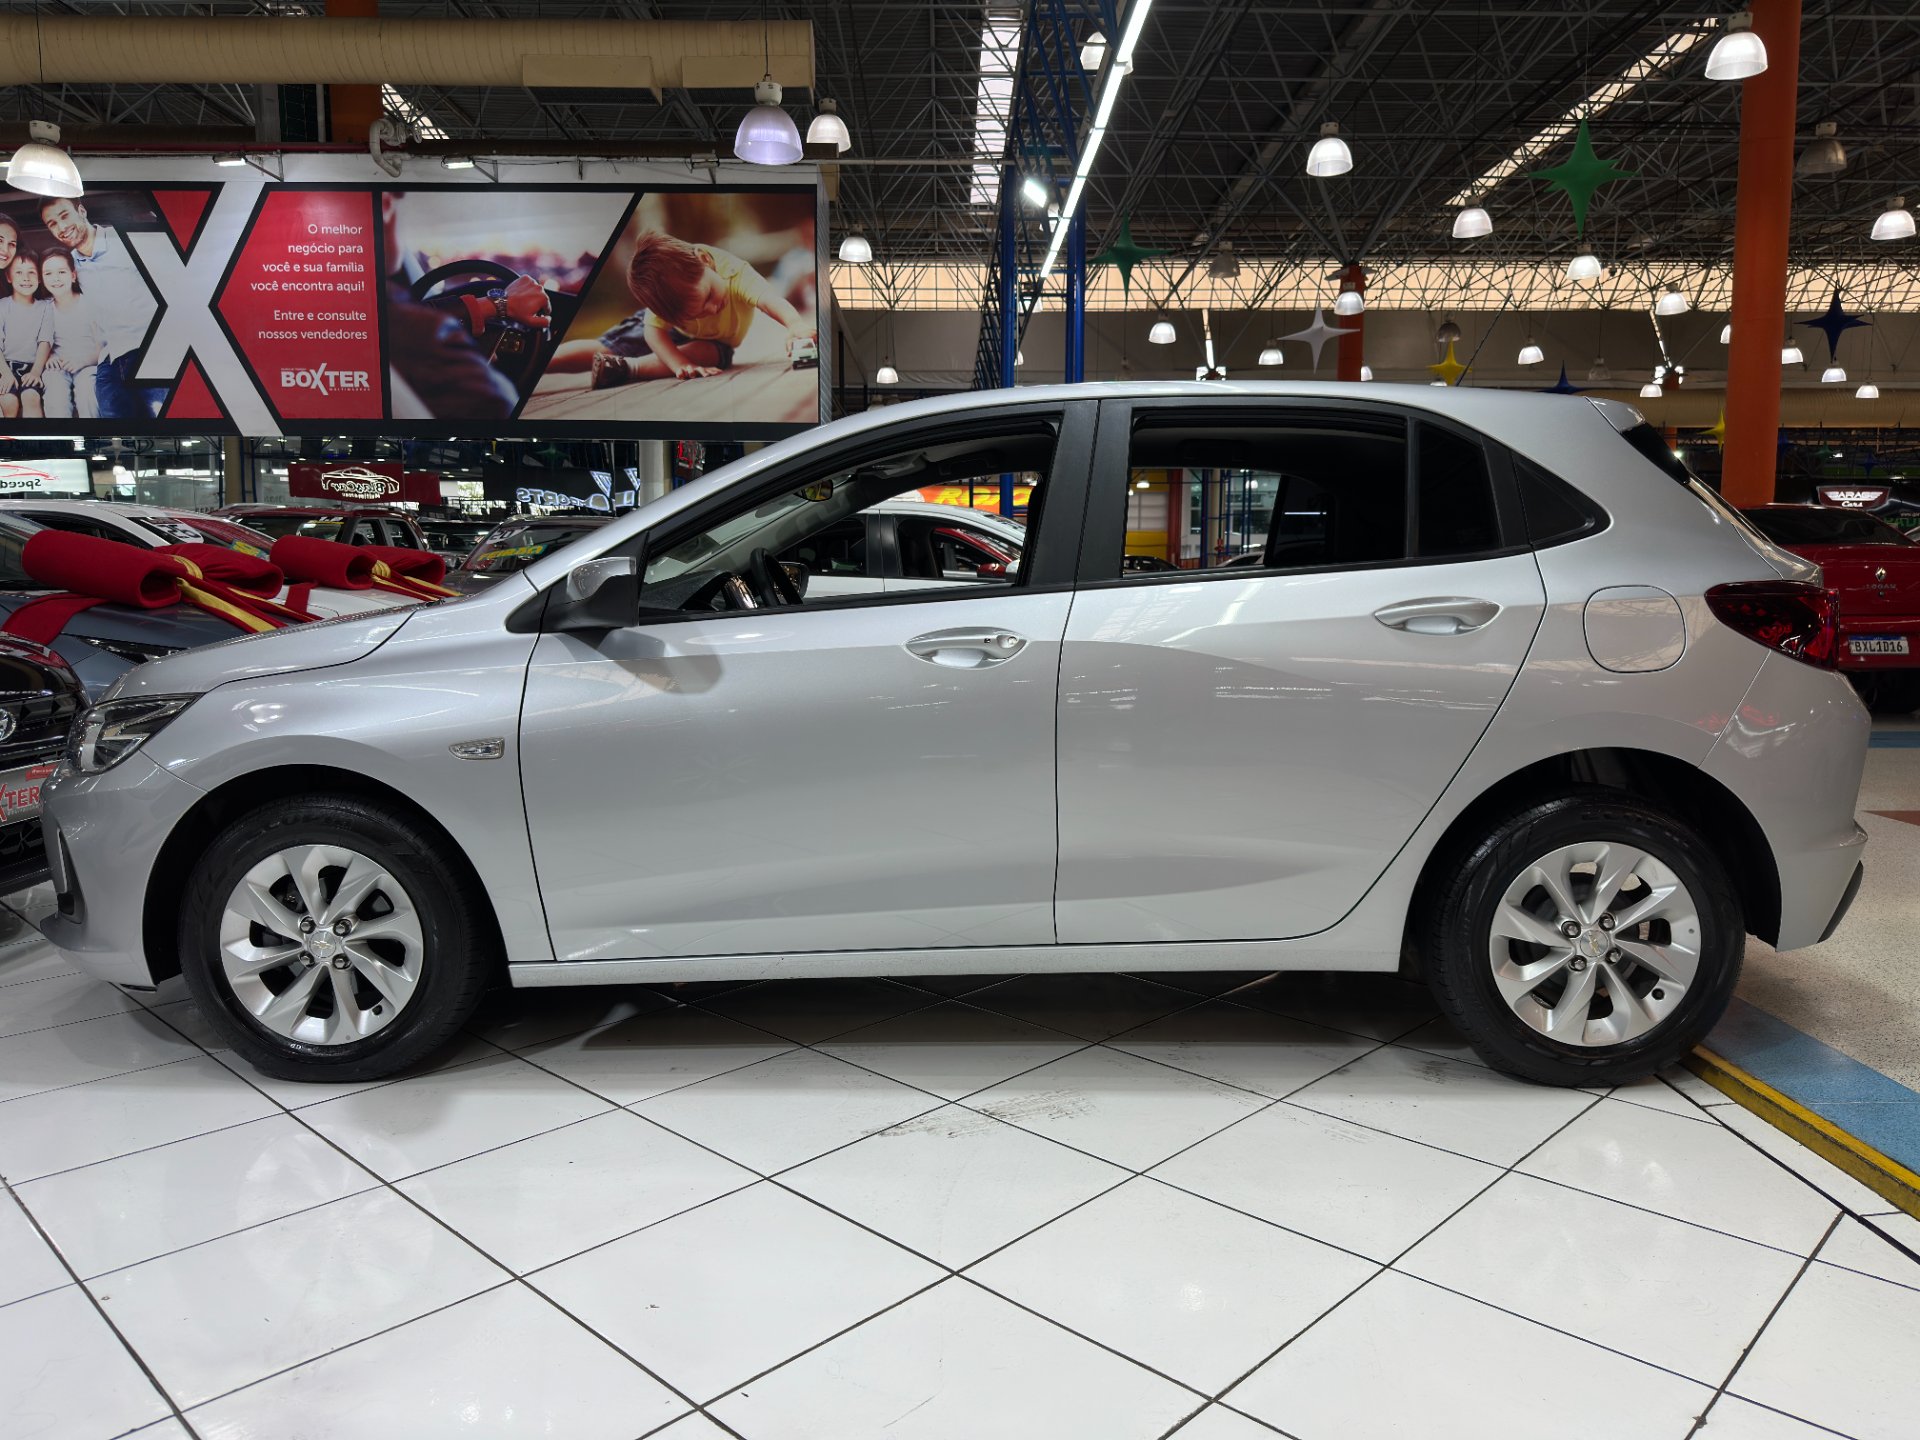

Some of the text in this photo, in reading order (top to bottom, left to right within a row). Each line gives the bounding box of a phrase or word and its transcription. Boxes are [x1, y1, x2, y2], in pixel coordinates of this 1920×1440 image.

[307, 223, 363, 235] O melhor
[287, 243, 364, 256] negócio para
[262, 261, 364, 273] você e sua família
[250, 280, 365, 294] você encontra aqui!
[273, 310, 367, 321] Entre e consulte
[258, 329, 368, 340] nossos vendedores
[280, 362, 370, 396] BOXTER
[1854, 641, 1903, 653] BXL1D16
